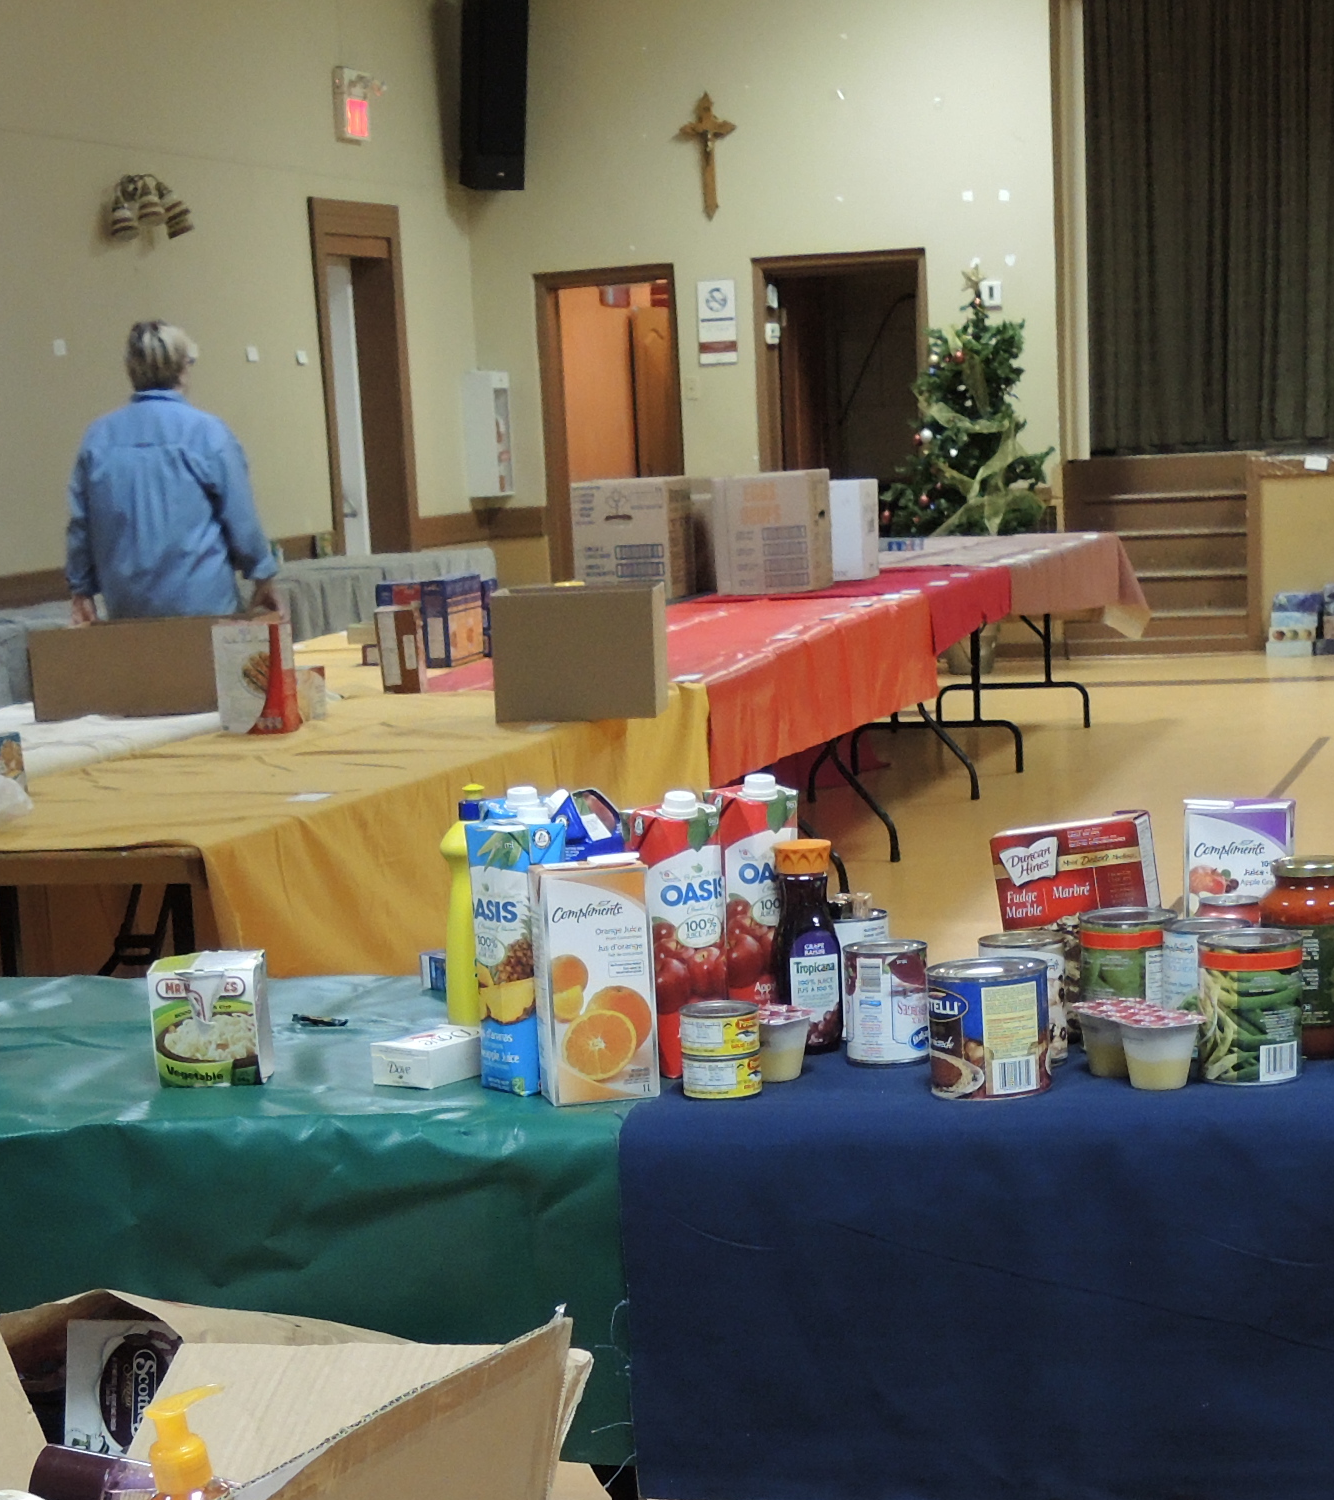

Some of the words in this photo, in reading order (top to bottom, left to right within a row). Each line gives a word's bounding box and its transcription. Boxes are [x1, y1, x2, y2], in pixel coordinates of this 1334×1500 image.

[1008, 847, 1051, 868] Duncan
[1194, 840, 1266, 860] Compliments
[1019, 860, 1050, 878] Hines
[1007, 890, 1038, 906] Fudge
[1052, 882, 1091, 899] Marbré
[472, 898, 518, 923] ASIS
[552, 900, 624, 924] Compliments
[1006, 904, 1043, 919] Marble
[685, 916, 718, 933] 100%
[794, 961, 836, 976] Tropicana
[166, 1064, 224, 1082] Vegetable
